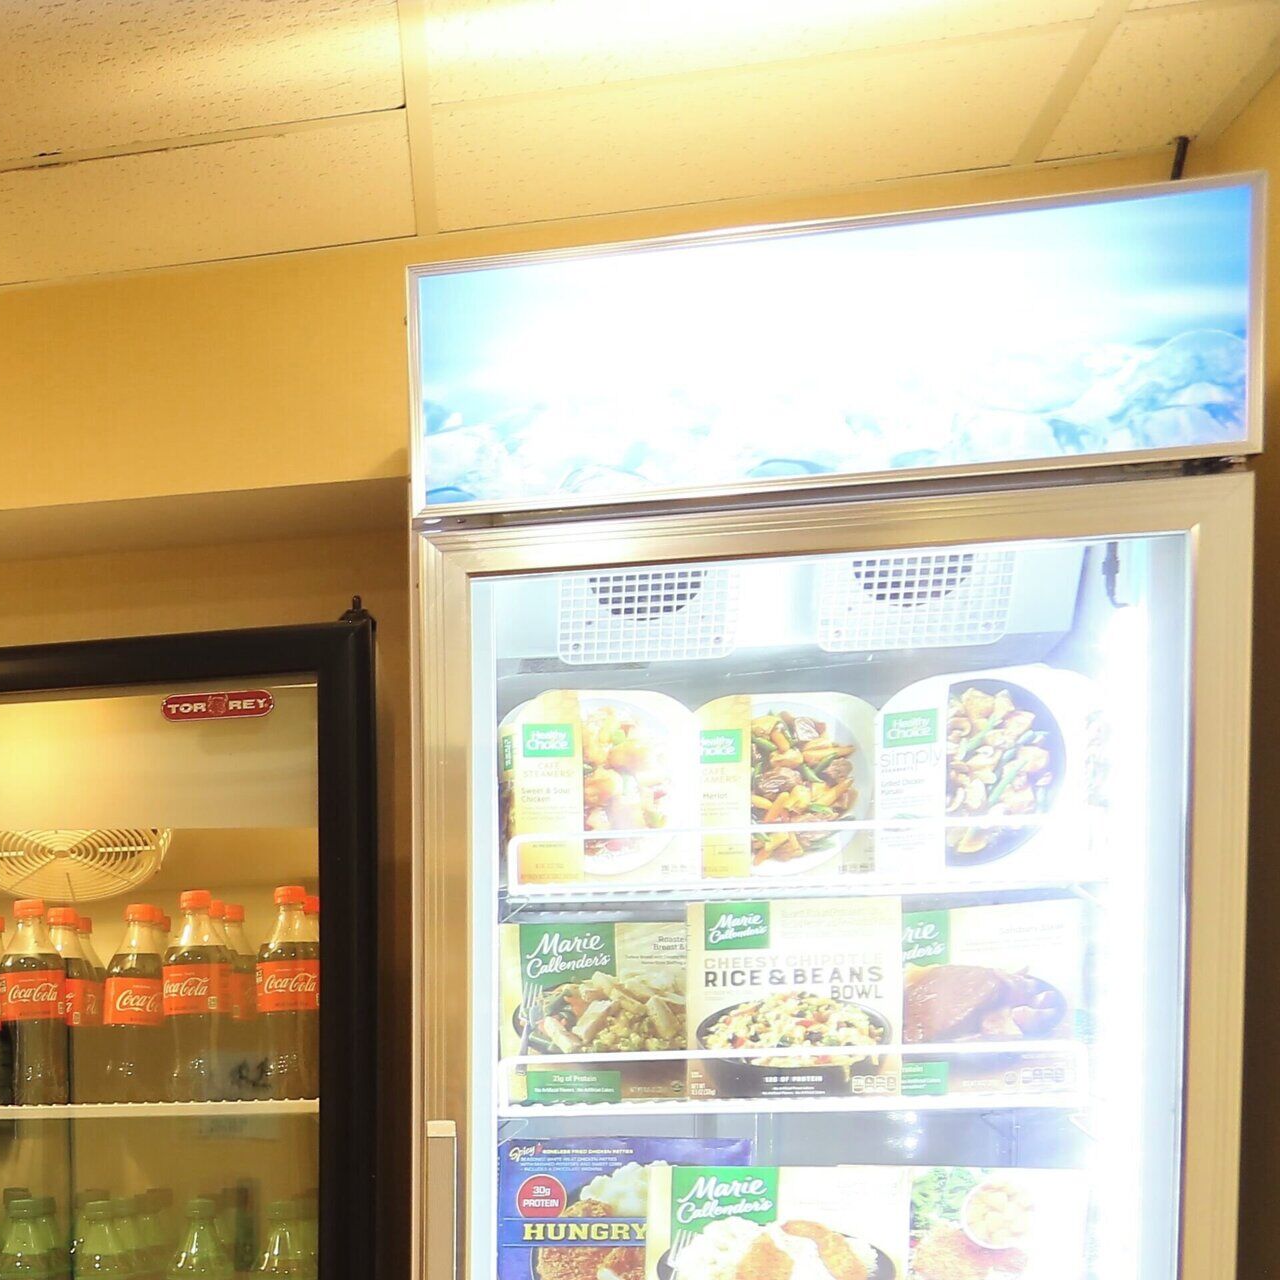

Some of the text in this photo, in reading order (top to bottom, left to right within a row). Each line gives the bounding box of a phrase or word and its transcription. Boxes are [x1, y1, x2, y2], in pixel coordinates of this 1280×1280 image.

[167, 698, 267, 714] TOR REY
[903, 921, 939, 943] rie
[527, 933, 604, 959] Marie
[526, 953, 611, 978] Callender's
[705, 955, 779, 969] CHEESY
[264, 973, 318, 994] Coca-Cola
[705, 966, 883, 987] RICE & BEANS
[8, 983, 58, 1003] Coca-Cola
[831, 985, 883, 999] BOWL
[509, 1146, 535, 1162] Spicy
[532, 1186, 550, 1196] 30g
[678, 1176, 768, 1202] Marie
[523, 1199, 559, 1208] PROTEIN
[523, 1223, 647, 1241] HUNGRY
